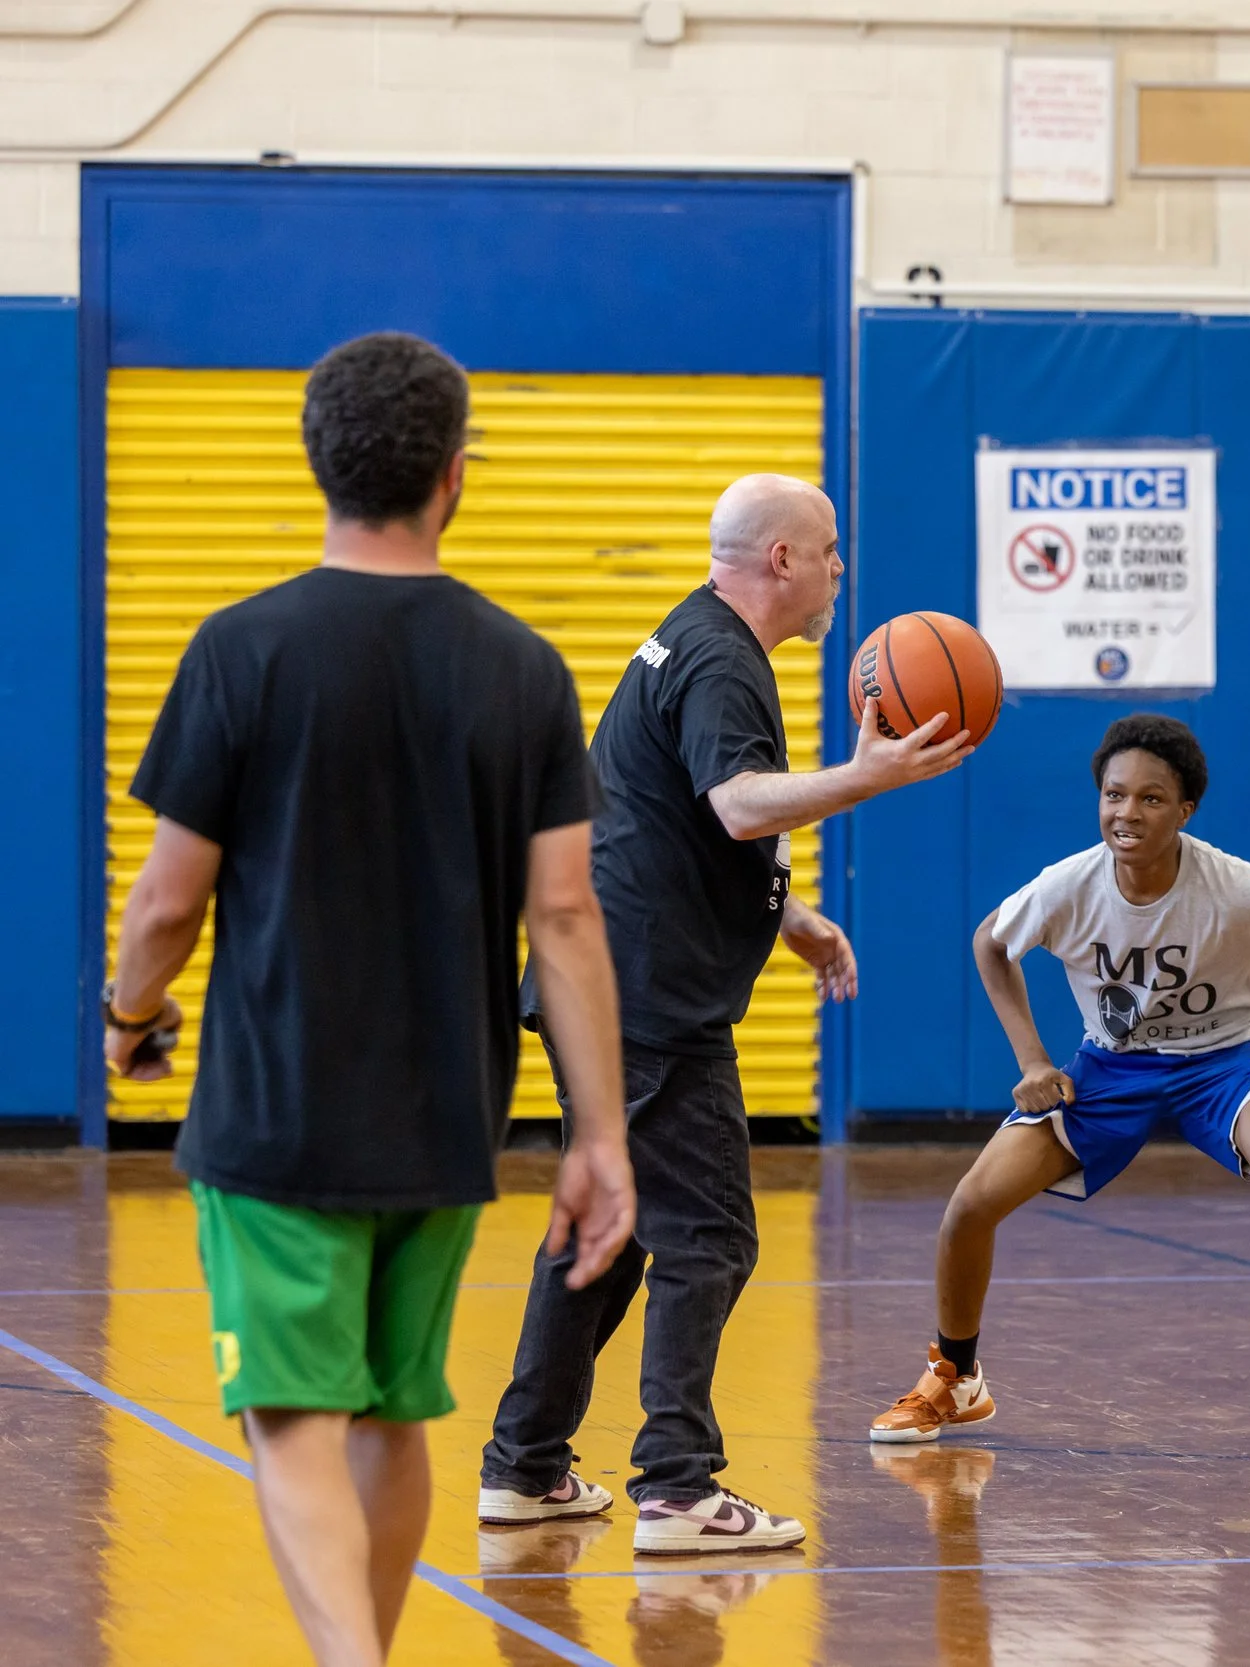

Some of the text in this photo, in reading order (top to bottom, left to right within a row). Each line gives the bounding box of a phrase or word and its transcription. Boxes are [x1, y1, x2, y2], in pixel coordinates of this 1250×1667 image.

[1015, 470, 1184, 508] NOTICE
[1086, 525, 1184, 543] NO FOOD
[1083, 548, 1187, 567] OR DRINK
[1084, 572, 1188, 592] ALLOWED
[1063, 620, 1142, 639] WATER
[1090, 942, 1188, 992] MS
[1183, 1019, 1219, 1039] THE
